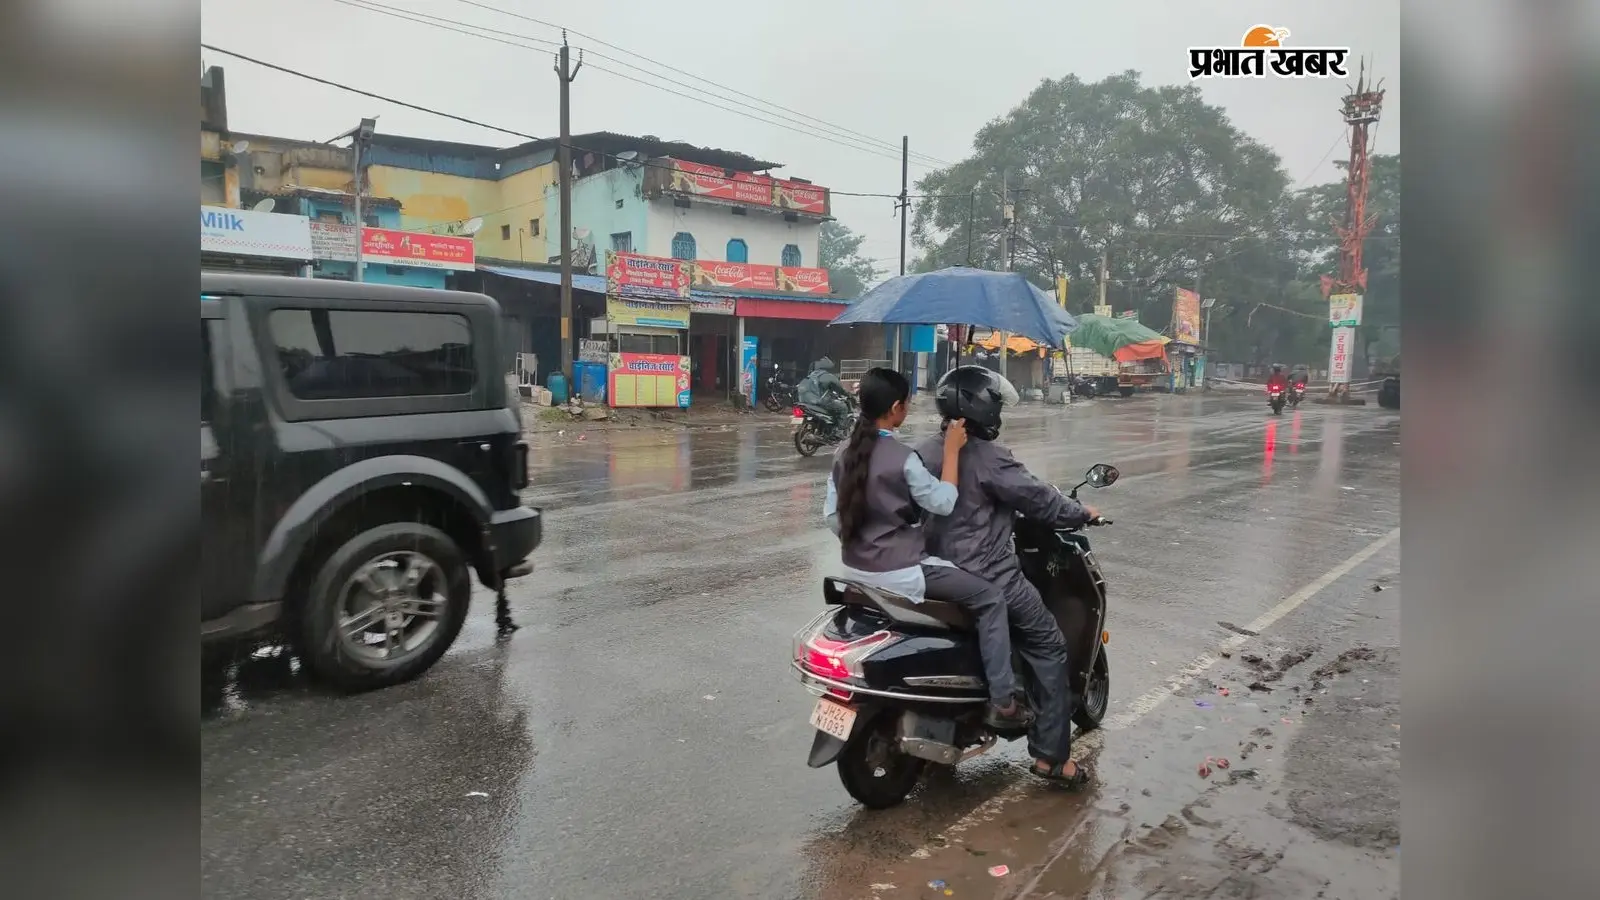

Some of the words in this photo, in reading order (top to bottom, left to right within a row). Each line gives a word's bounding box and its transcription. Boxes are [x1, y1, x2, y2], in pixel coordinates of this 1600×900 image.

[735, 192, 768, 202] BHANDAR
[201, 211, 244, 232] Milk
[714, 264, 745, 278] Coca-Cola
[823, 704, 848, 722] JH24
